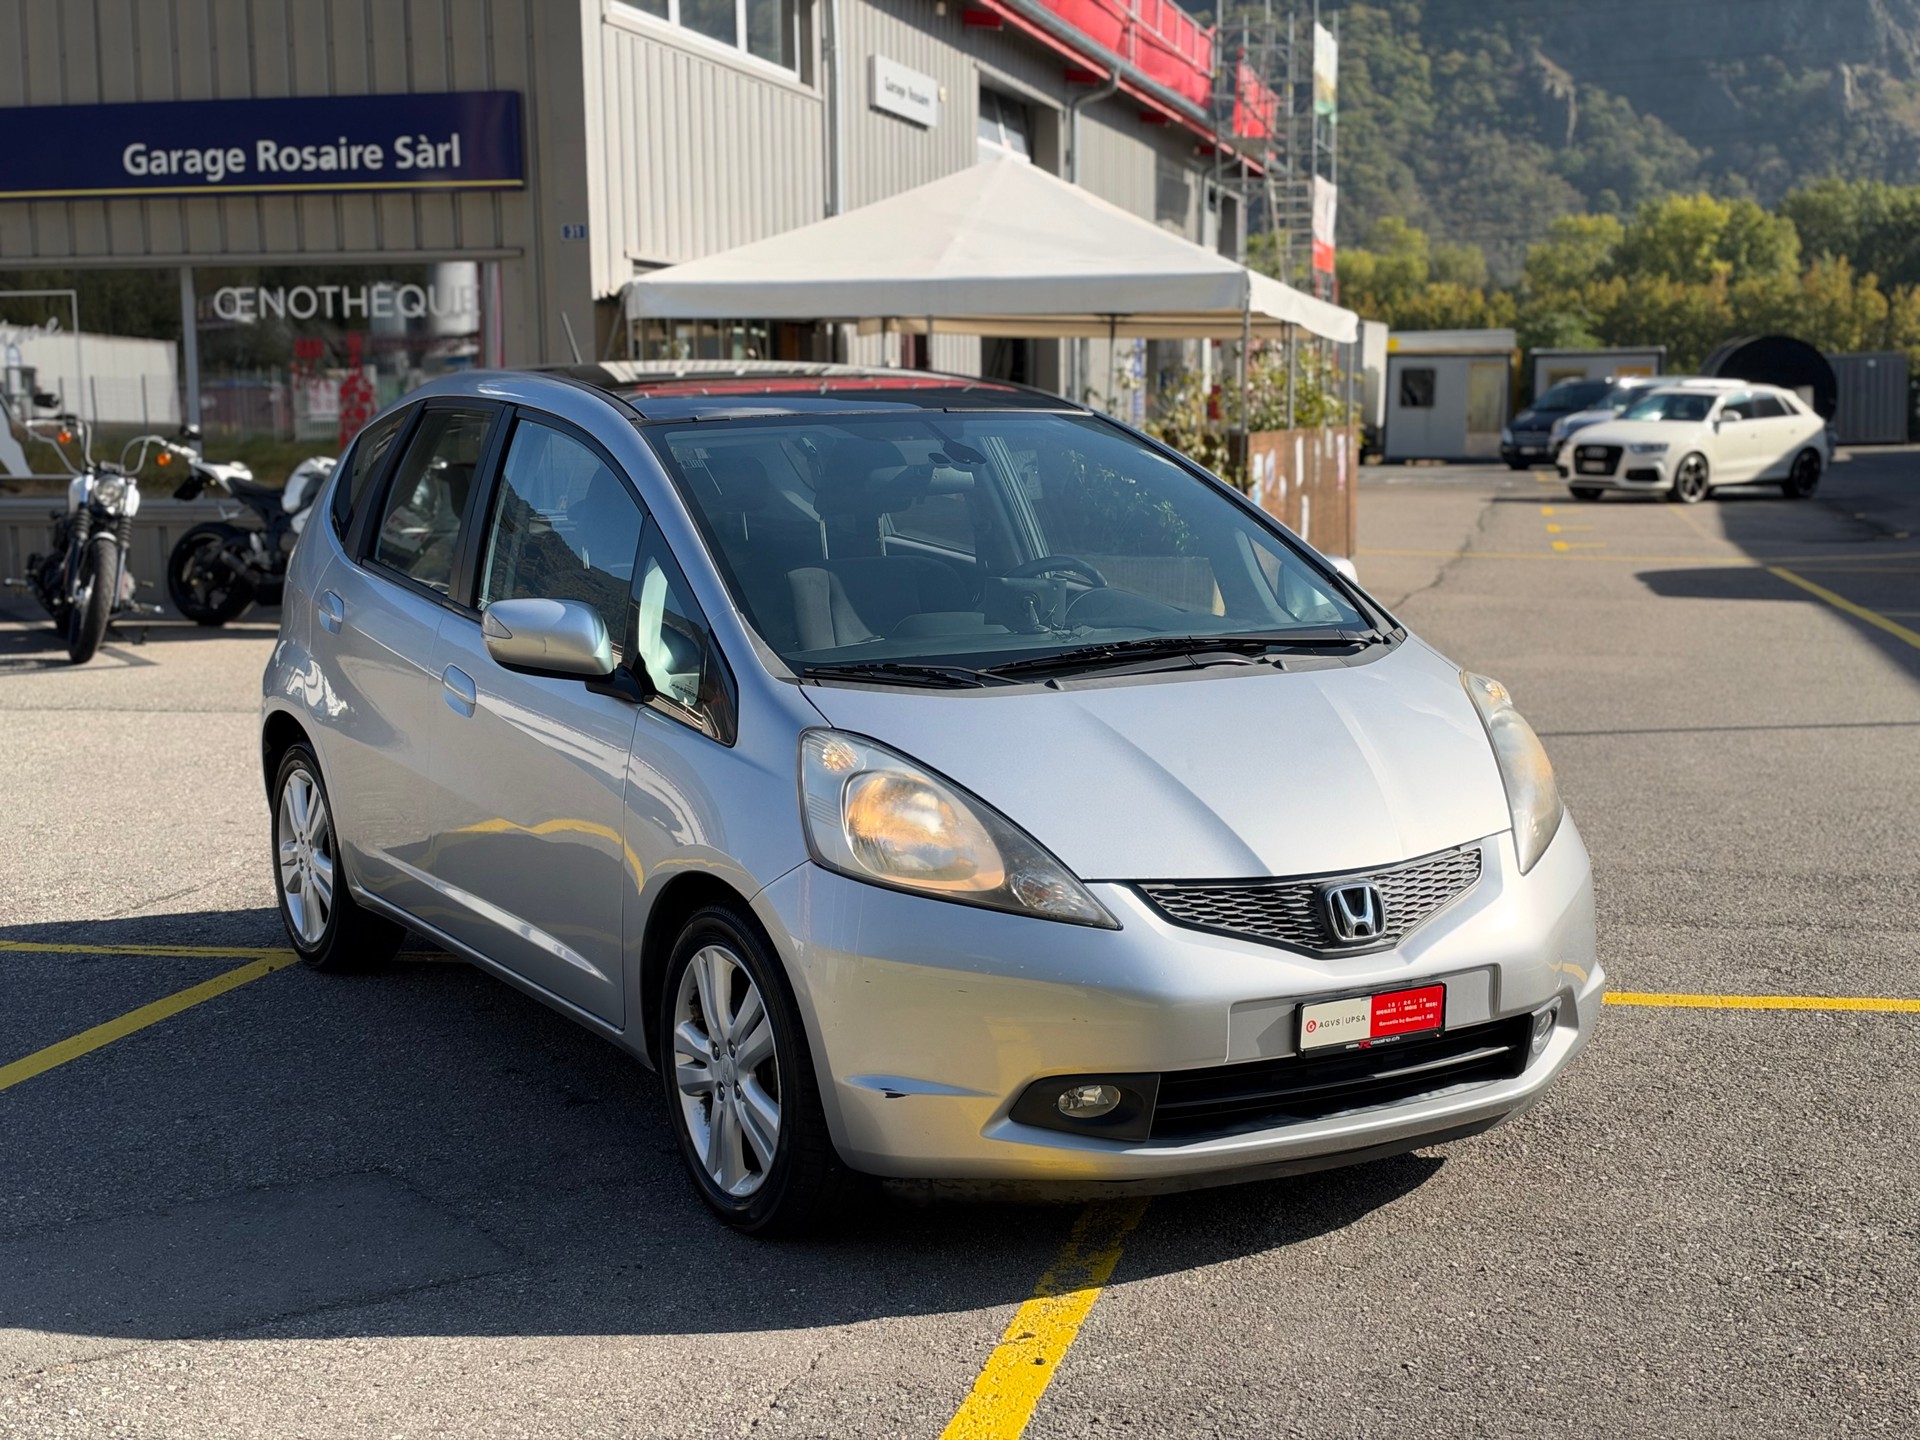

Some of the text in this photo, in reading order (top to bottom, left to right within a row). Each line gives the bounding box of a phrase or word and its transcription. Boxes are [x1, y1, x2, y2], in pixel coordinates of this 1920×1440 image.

[122, 133, 462, 182] Garage Rosaire Sàrl
[1318, 1014, 1366, 1028] AGVS UPSA
